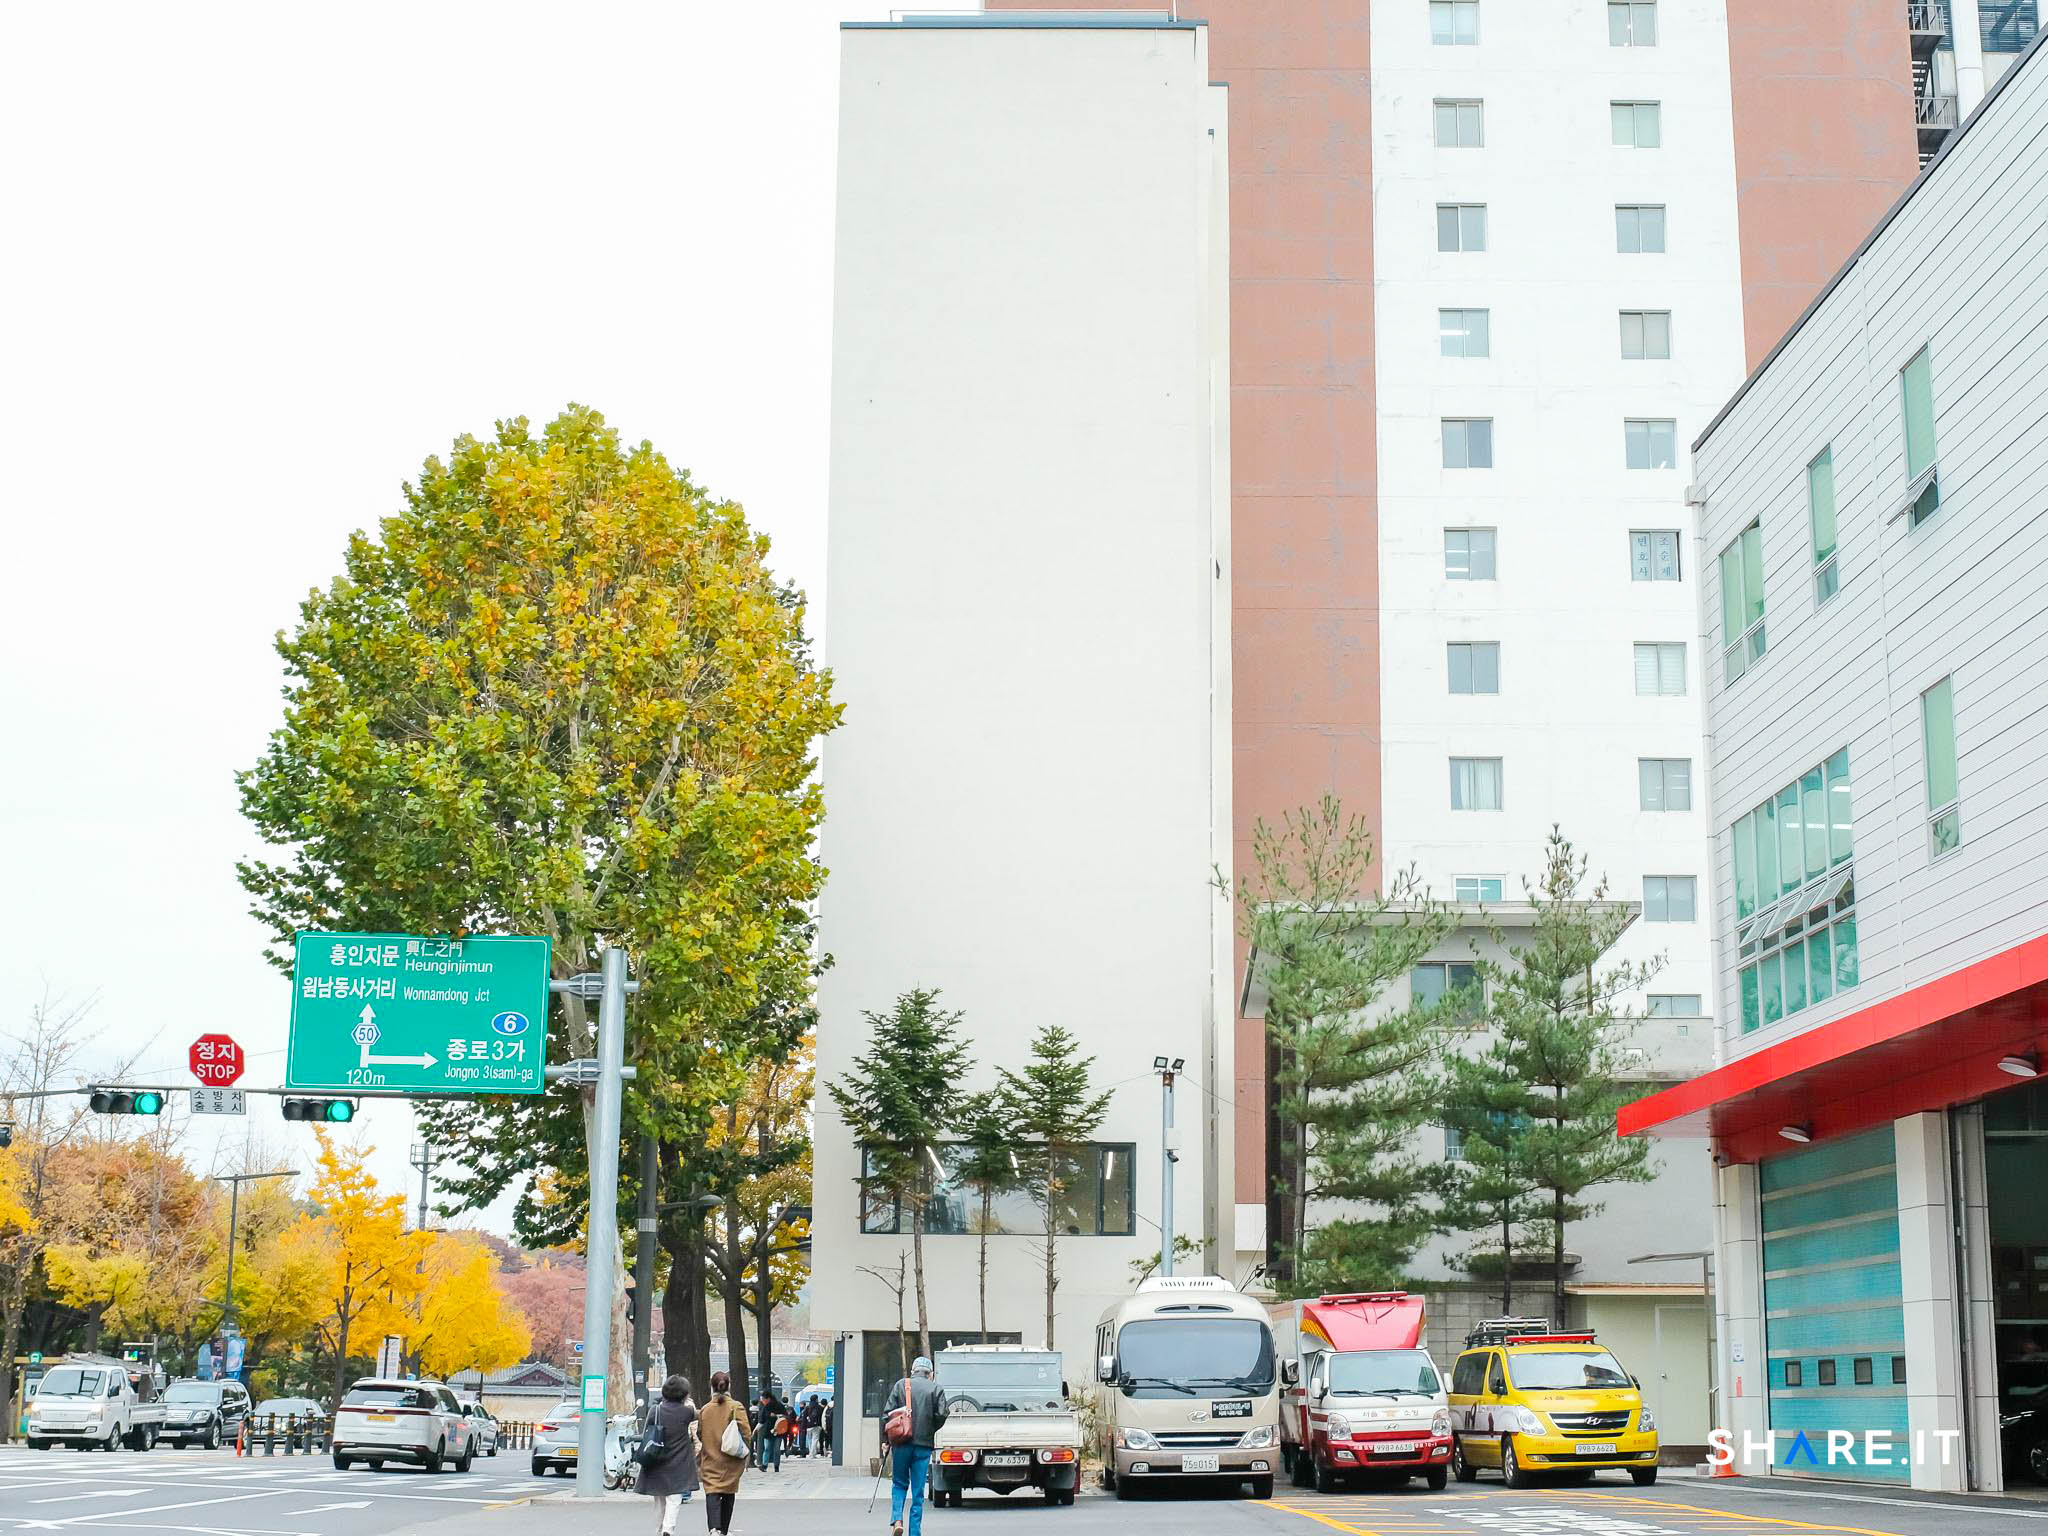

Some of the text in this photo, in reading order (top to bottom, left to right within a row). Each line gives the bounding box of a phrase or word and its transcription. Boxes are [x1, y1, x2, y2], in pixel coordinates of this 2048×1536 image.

[329, 943, 400, 967] 흥인지문
[406, 940, 463, 957] 興仁之門
[405, 959, 493, 975] Heunginjimun
[302, 976, 396, 999] 원남동사거리
[403, 986, 490, 1005] Wonnamdong Jct
[504, 1014, 518, 1032] 6
[358, 1027, 374, 1041] 50
[196, 1041, 236, 1061] 정지
[446, 1039, 526, 1062] 종로3가
[196, 1063, 236, 1079] STOP
[345, 1069, 386, 1085] 120m
[444, 1064, 534, 1083] Jongno 3(sam)-ga
